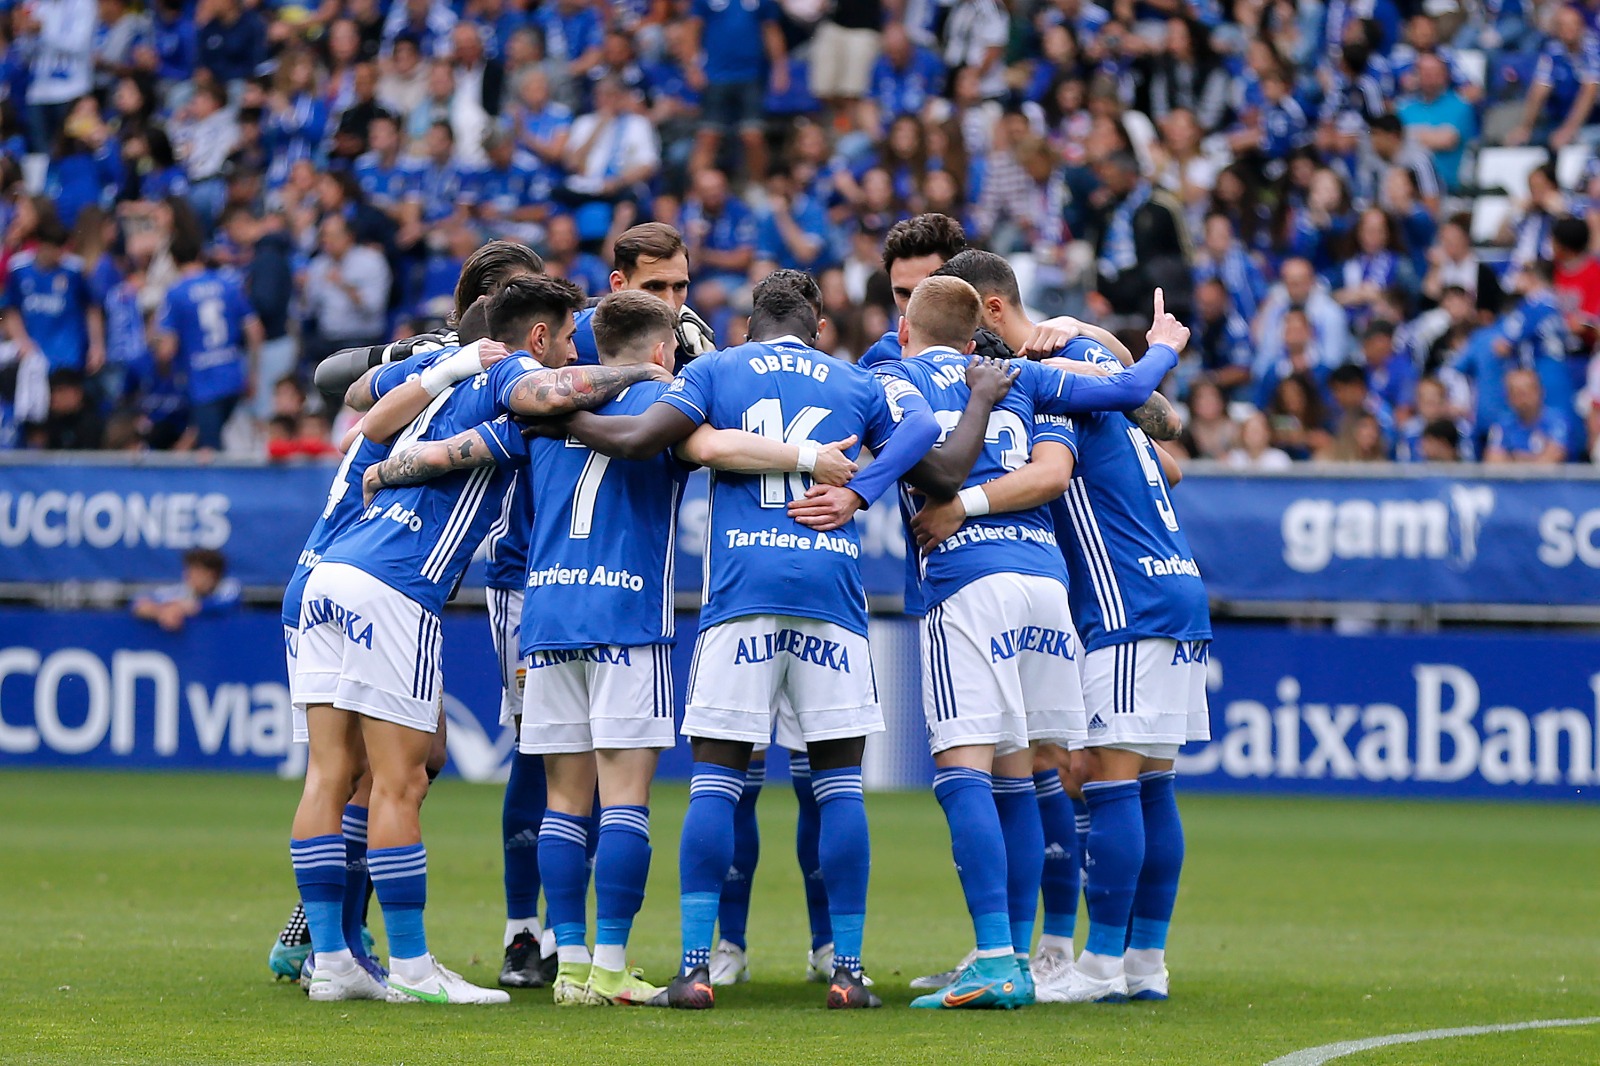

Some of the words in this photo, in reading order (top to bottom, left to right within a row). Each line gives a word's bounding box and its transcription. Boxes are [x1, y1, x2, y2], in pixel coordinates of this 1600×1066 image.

[748, 354, 830, 383] OBENG
[382, 502, 423, 532] Auto
[725, 527, 811, 550] Tartiere
[814, 532, 859, 559] Auto
[1019, 525, 1058, 547] Auto
[298, 548, 323, 568] uto
[527, 562, 588, 588] artiere
[589, 565, 645, 592] Auto
[734, 628, 851, 674] ALIMERKA
[1176, 656, 1600, 785] aixaBan
